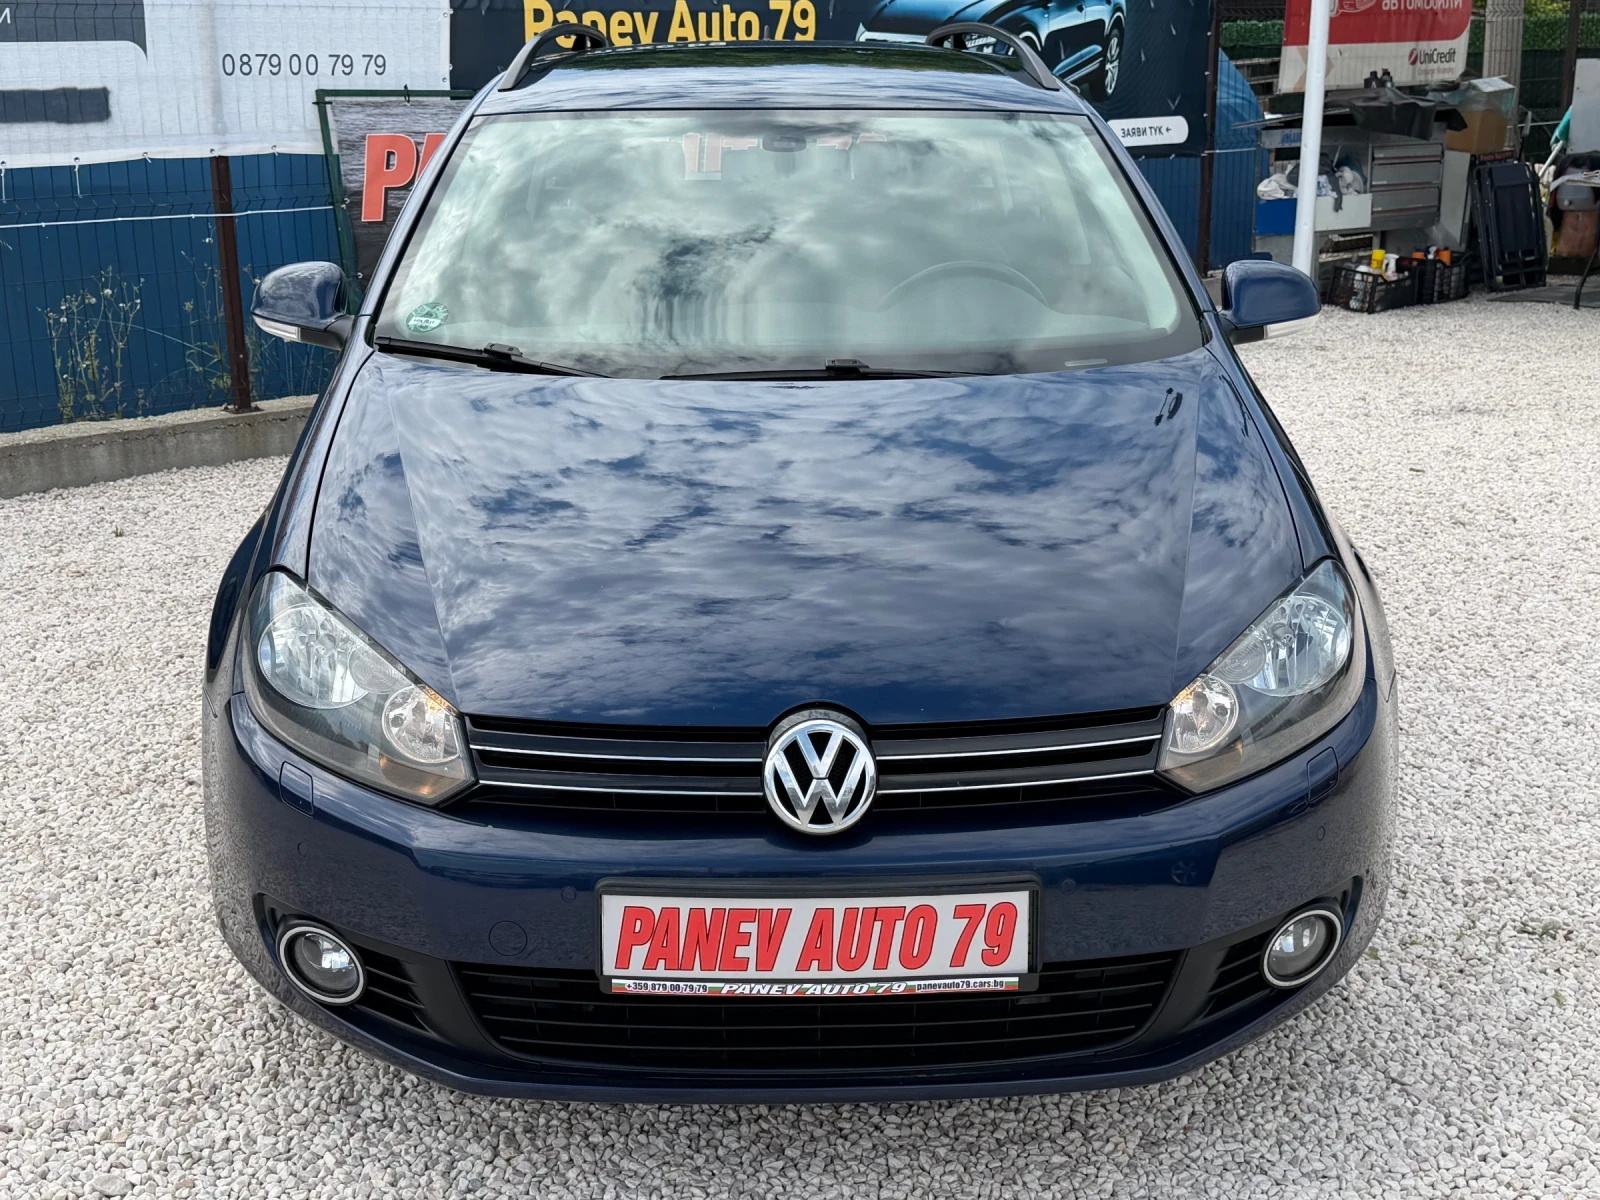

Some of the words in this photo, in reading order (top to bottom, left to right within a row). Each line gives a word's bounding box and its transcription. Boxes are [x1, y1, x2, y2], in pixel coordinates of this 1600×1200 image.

[667, 0, 760, 43] Auto
[769, 0, 816, 42] 79
[1419, 47, 1456, 65] UniCredit
[222, 53, 282, 77] 0879
[289, 53, 319, 76] 00
[328, 54, 354, 76] 79
[362, 54, 387, 76] 79
[1120, 126, 1148, 138] ЗАЯВИ
[1148, 125, 1164, 137] ТУК
[614, 905, 793, 973] PANEV
[795, 903, 939, 972] AUTO
[949, 901, 1019, 968] 79
[625, 981, 649, 992] +359
[651, 982, 668, 993] 879
[669, 982, 682, 993] 00
[683, 983, 695, 993] 79
[696, 983, 709, 994] 79
[720, 982, 803, 996] PANEV
[803, 983, 872, 996] AUTO
[875, 982, 908, 994] 79
[916, 978, 1005, 992] panevauto79.cars.bg
